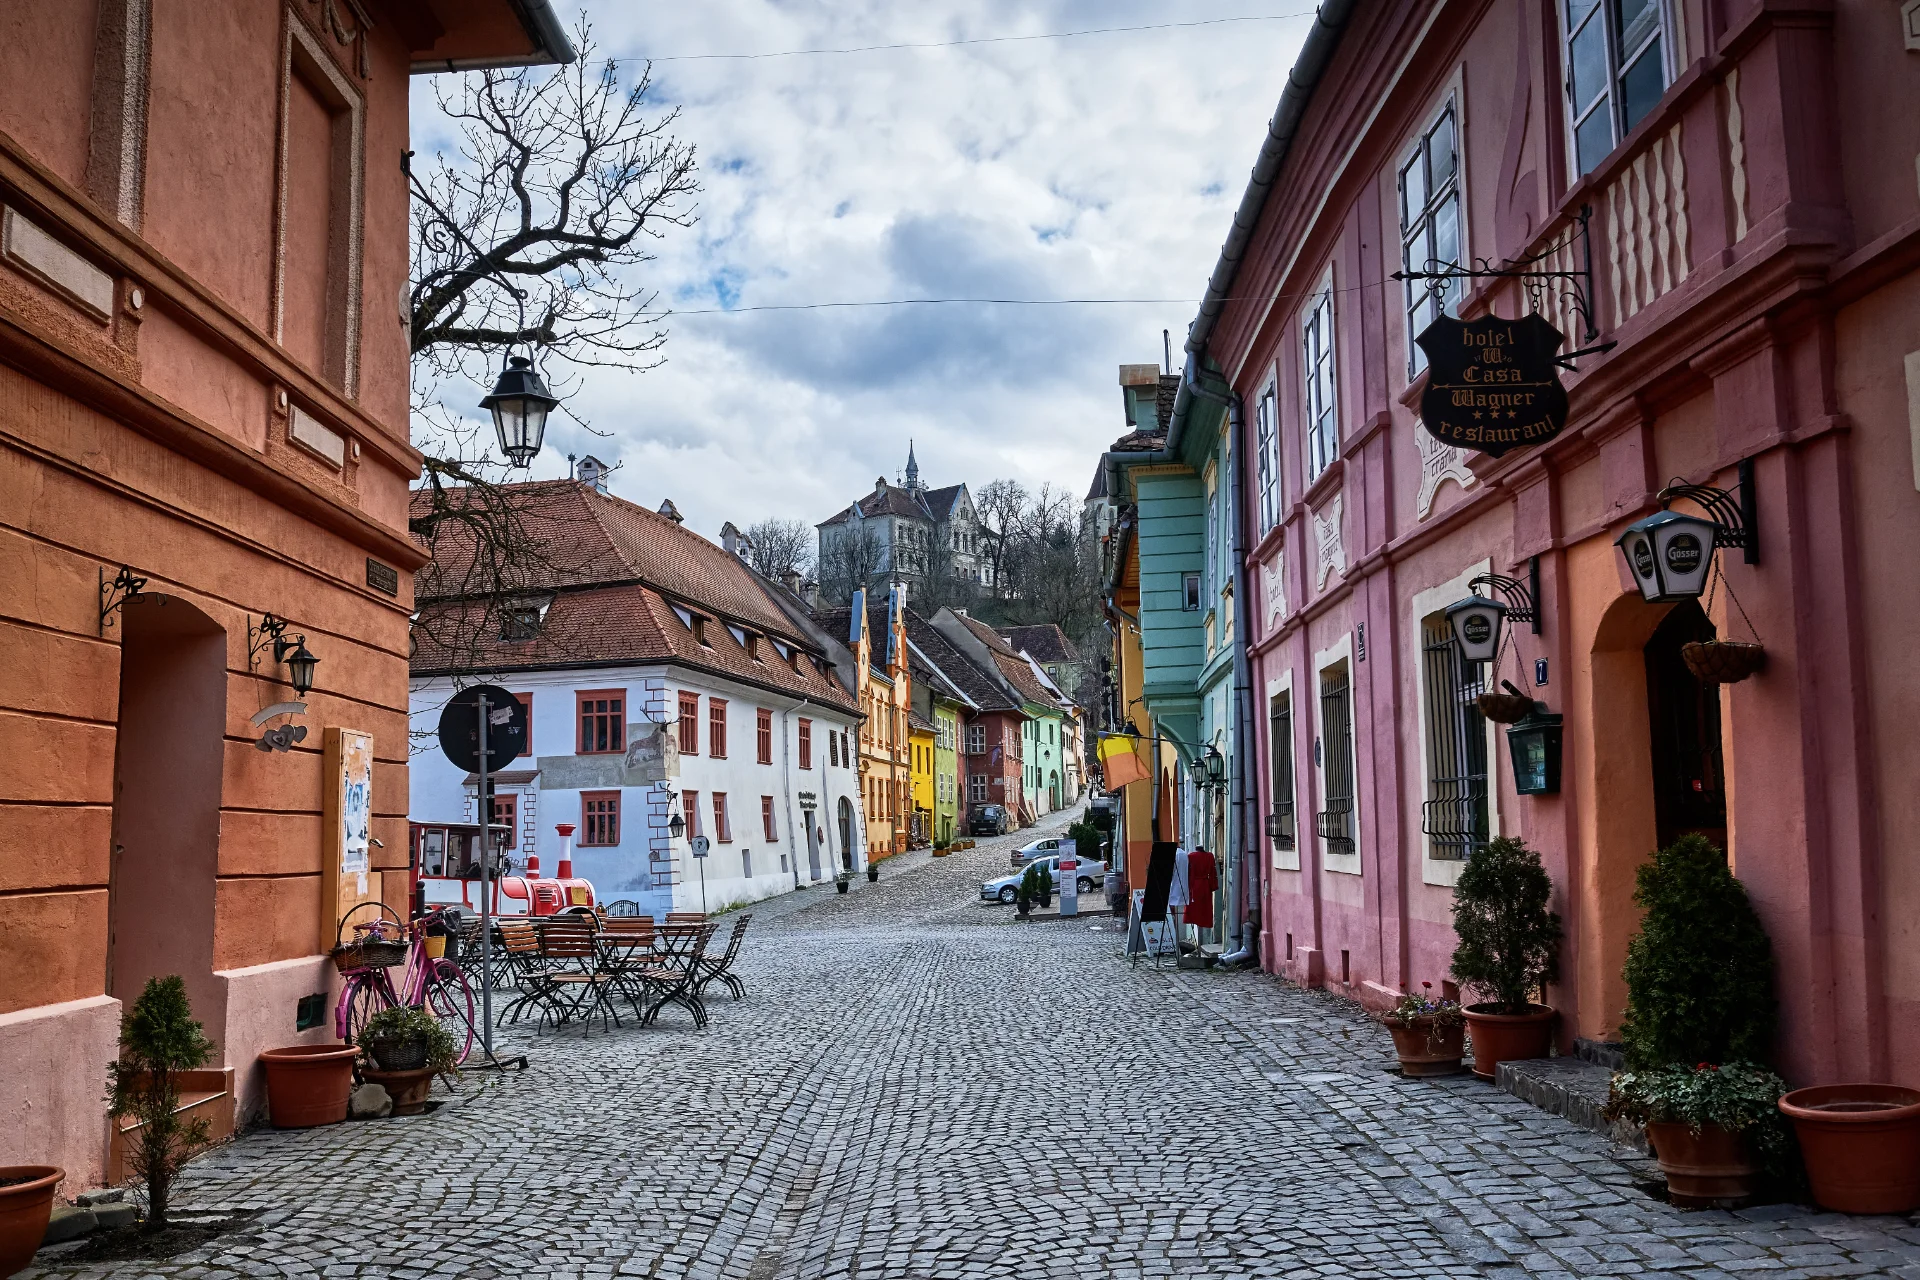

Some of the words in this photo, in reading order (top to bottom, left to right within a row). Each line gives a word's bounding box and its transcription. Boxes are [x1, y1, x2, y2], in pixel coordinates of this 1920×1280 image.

[1463, 327, 1514, 346] hotel
[1482, 348, 1502, 363] W
[1463, 365, 1522, 383] Casa
[1451, 389, 1535, 410] Wagner
[1440, 414, 1556, 443] restaurant
[1668, 546, 1699, 560] Gösser
[1465, 624, 1489, 635] Gösser
[1538, 663, 1543, 681] 7
